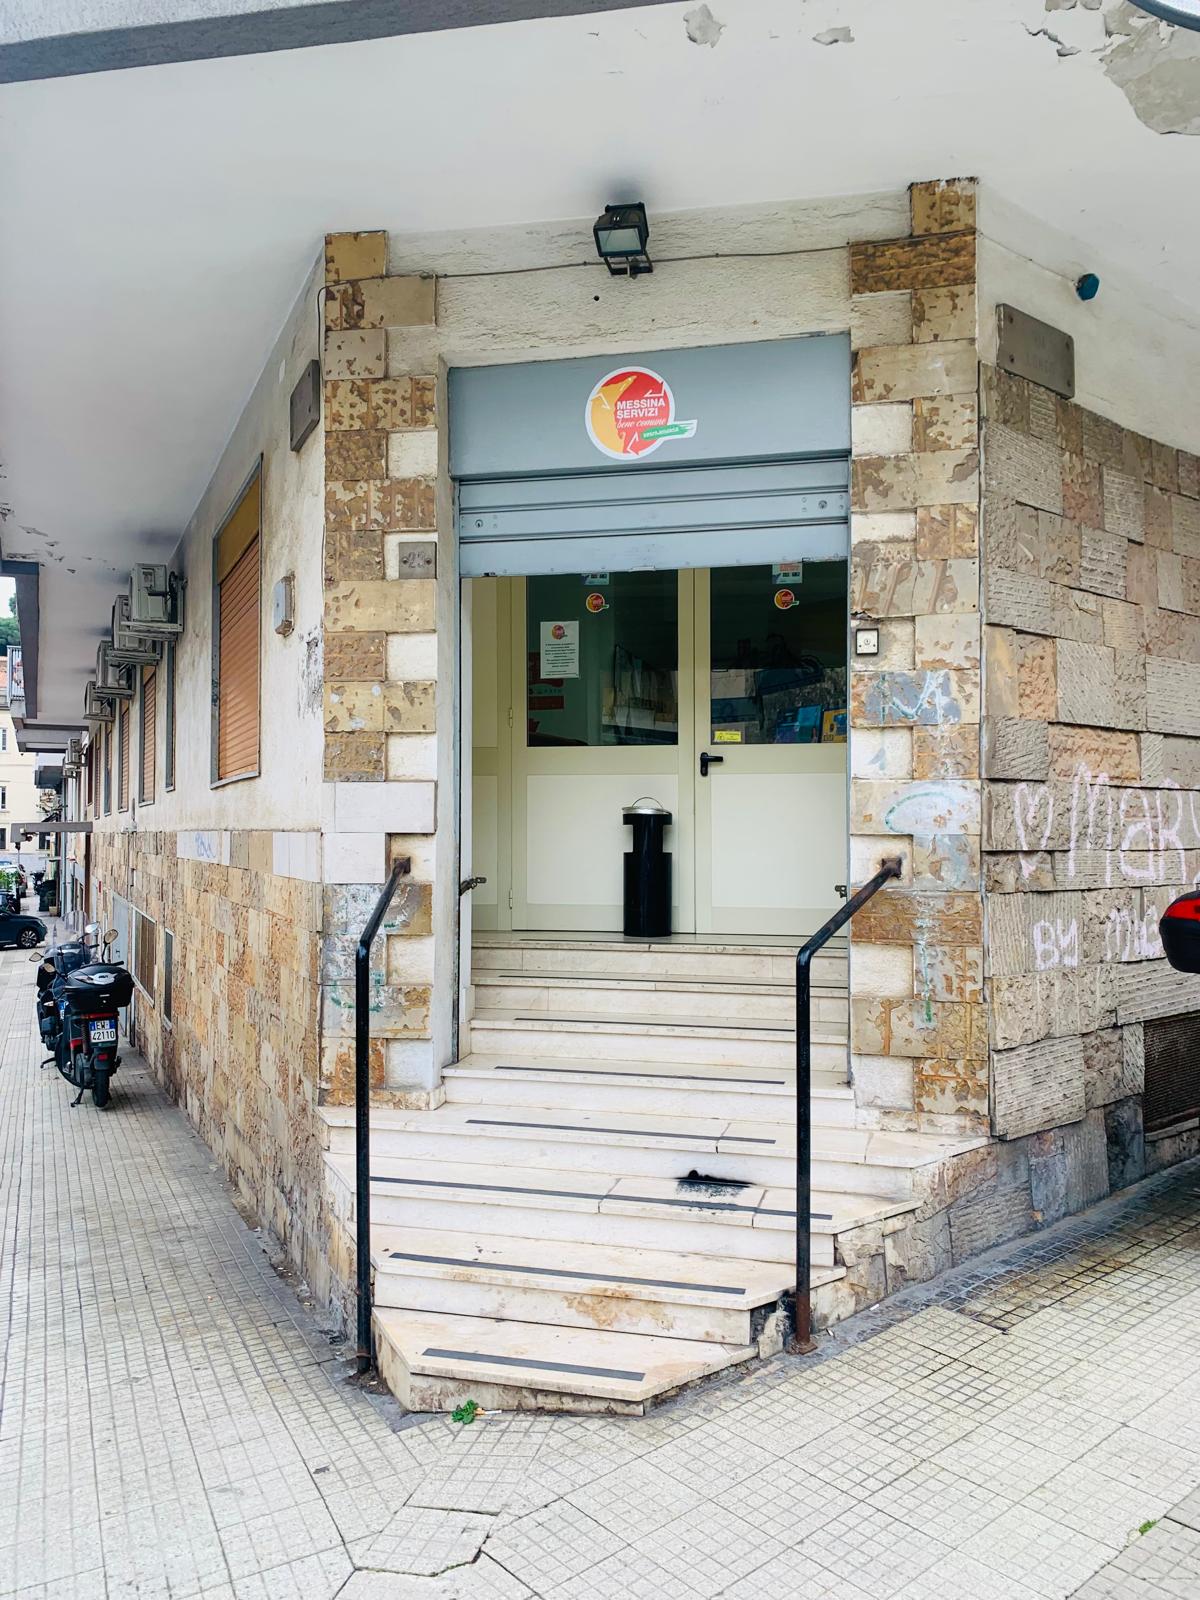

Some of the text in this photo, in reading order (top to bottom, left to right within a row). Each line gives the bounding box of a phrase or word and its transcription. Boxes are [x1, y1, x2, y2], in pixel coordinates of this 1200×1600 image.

[616, 398, 666, 410] MESSINA
[616, 407, 659, 419] SERVIZI
[92, 1030, 115, 1041] 42110
